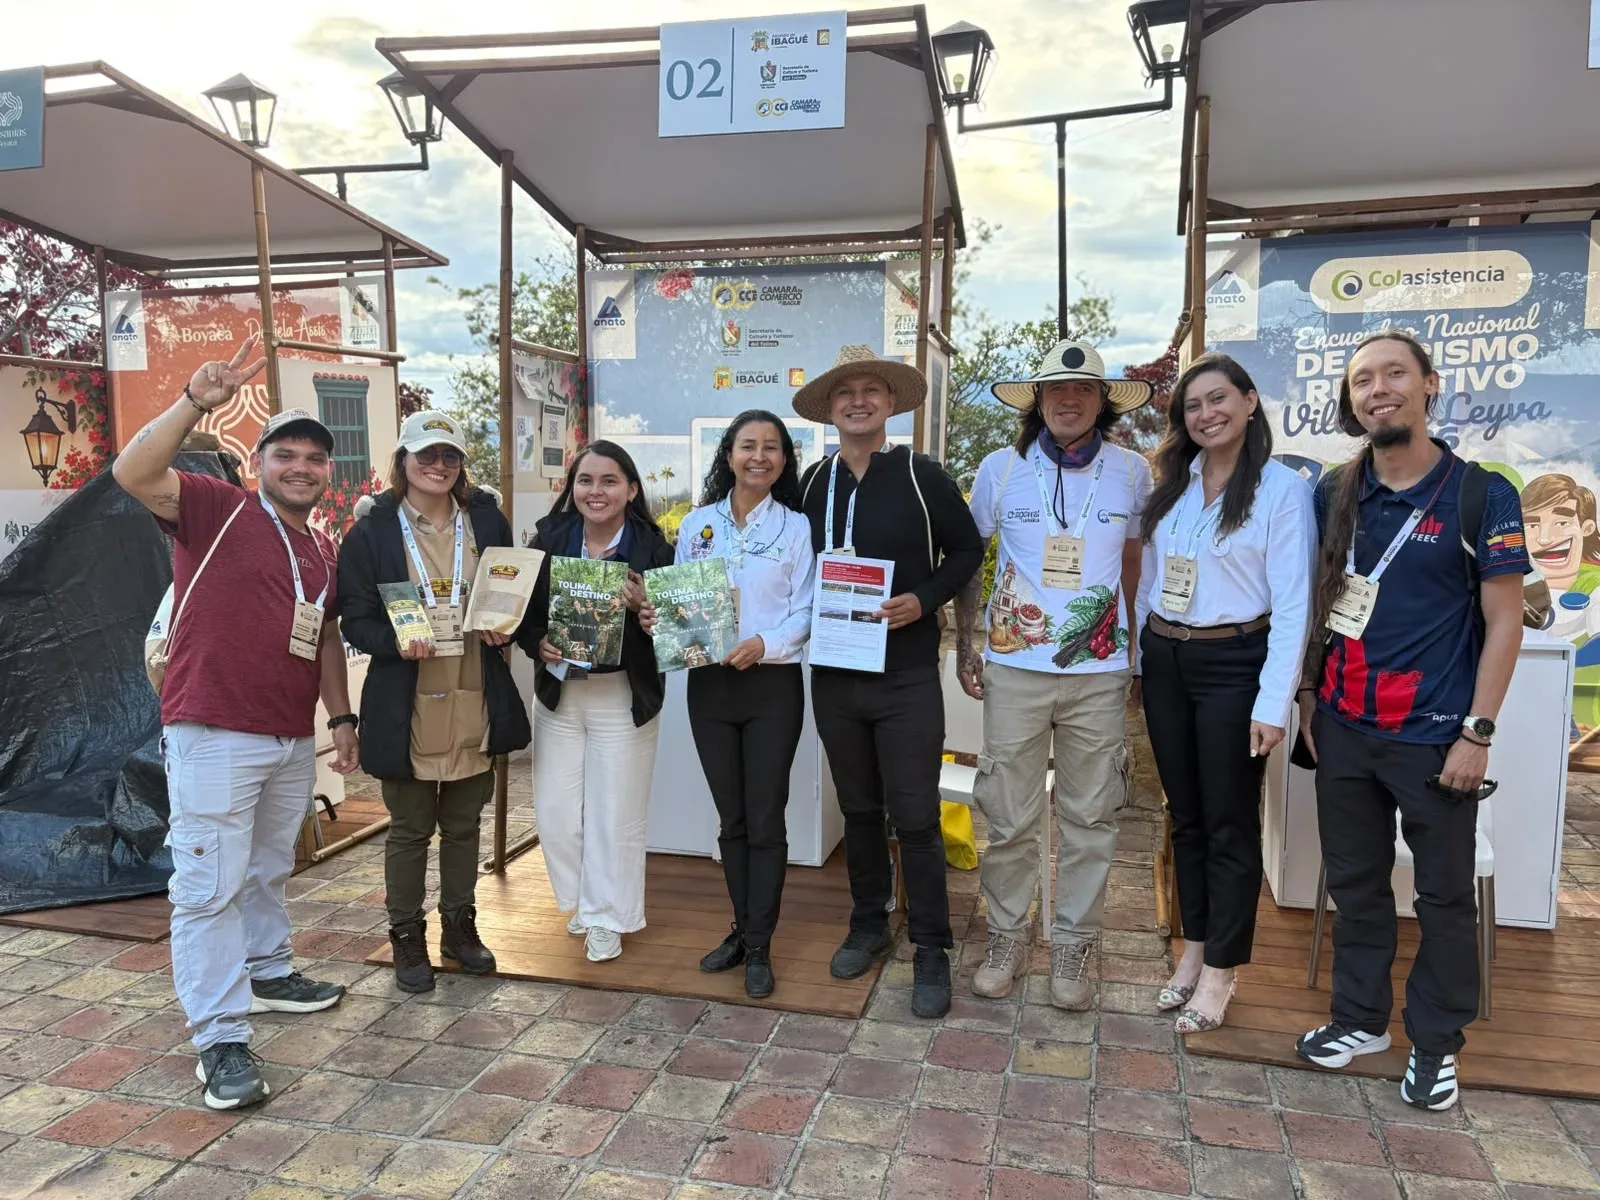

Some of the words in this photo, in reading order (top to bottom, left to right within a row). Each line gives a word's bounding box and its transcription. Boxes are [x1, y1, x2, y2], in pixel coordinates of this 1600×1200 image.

[771, 34, 808, 45] IBAGUÉ
[666, 58, 724, 100] 02
[1368, 266, 1505, 287] Colasistencia
[760, 292, 802, 301] COMERCIO
[1207, 294, 1246, 304] anato
[594, 318, 626, 327] anato
[1424, 303, 1540, 337] Nacional
[112, 333, 138, 343] anato
[1296, 350, 1345, 378] DE
[736, 372, 779, 384] IBAGUÉ
[1440, 391, 1552, 442] Leyva
[1410, 533, 1439, 544] FEEC
[558, 580, 592, 591] TOLIMA
[570, 589, 611, 601] DESTINO
[655, 587, 693, 600] TOLIMA
[671, 590, 714, 604] DESTINO
